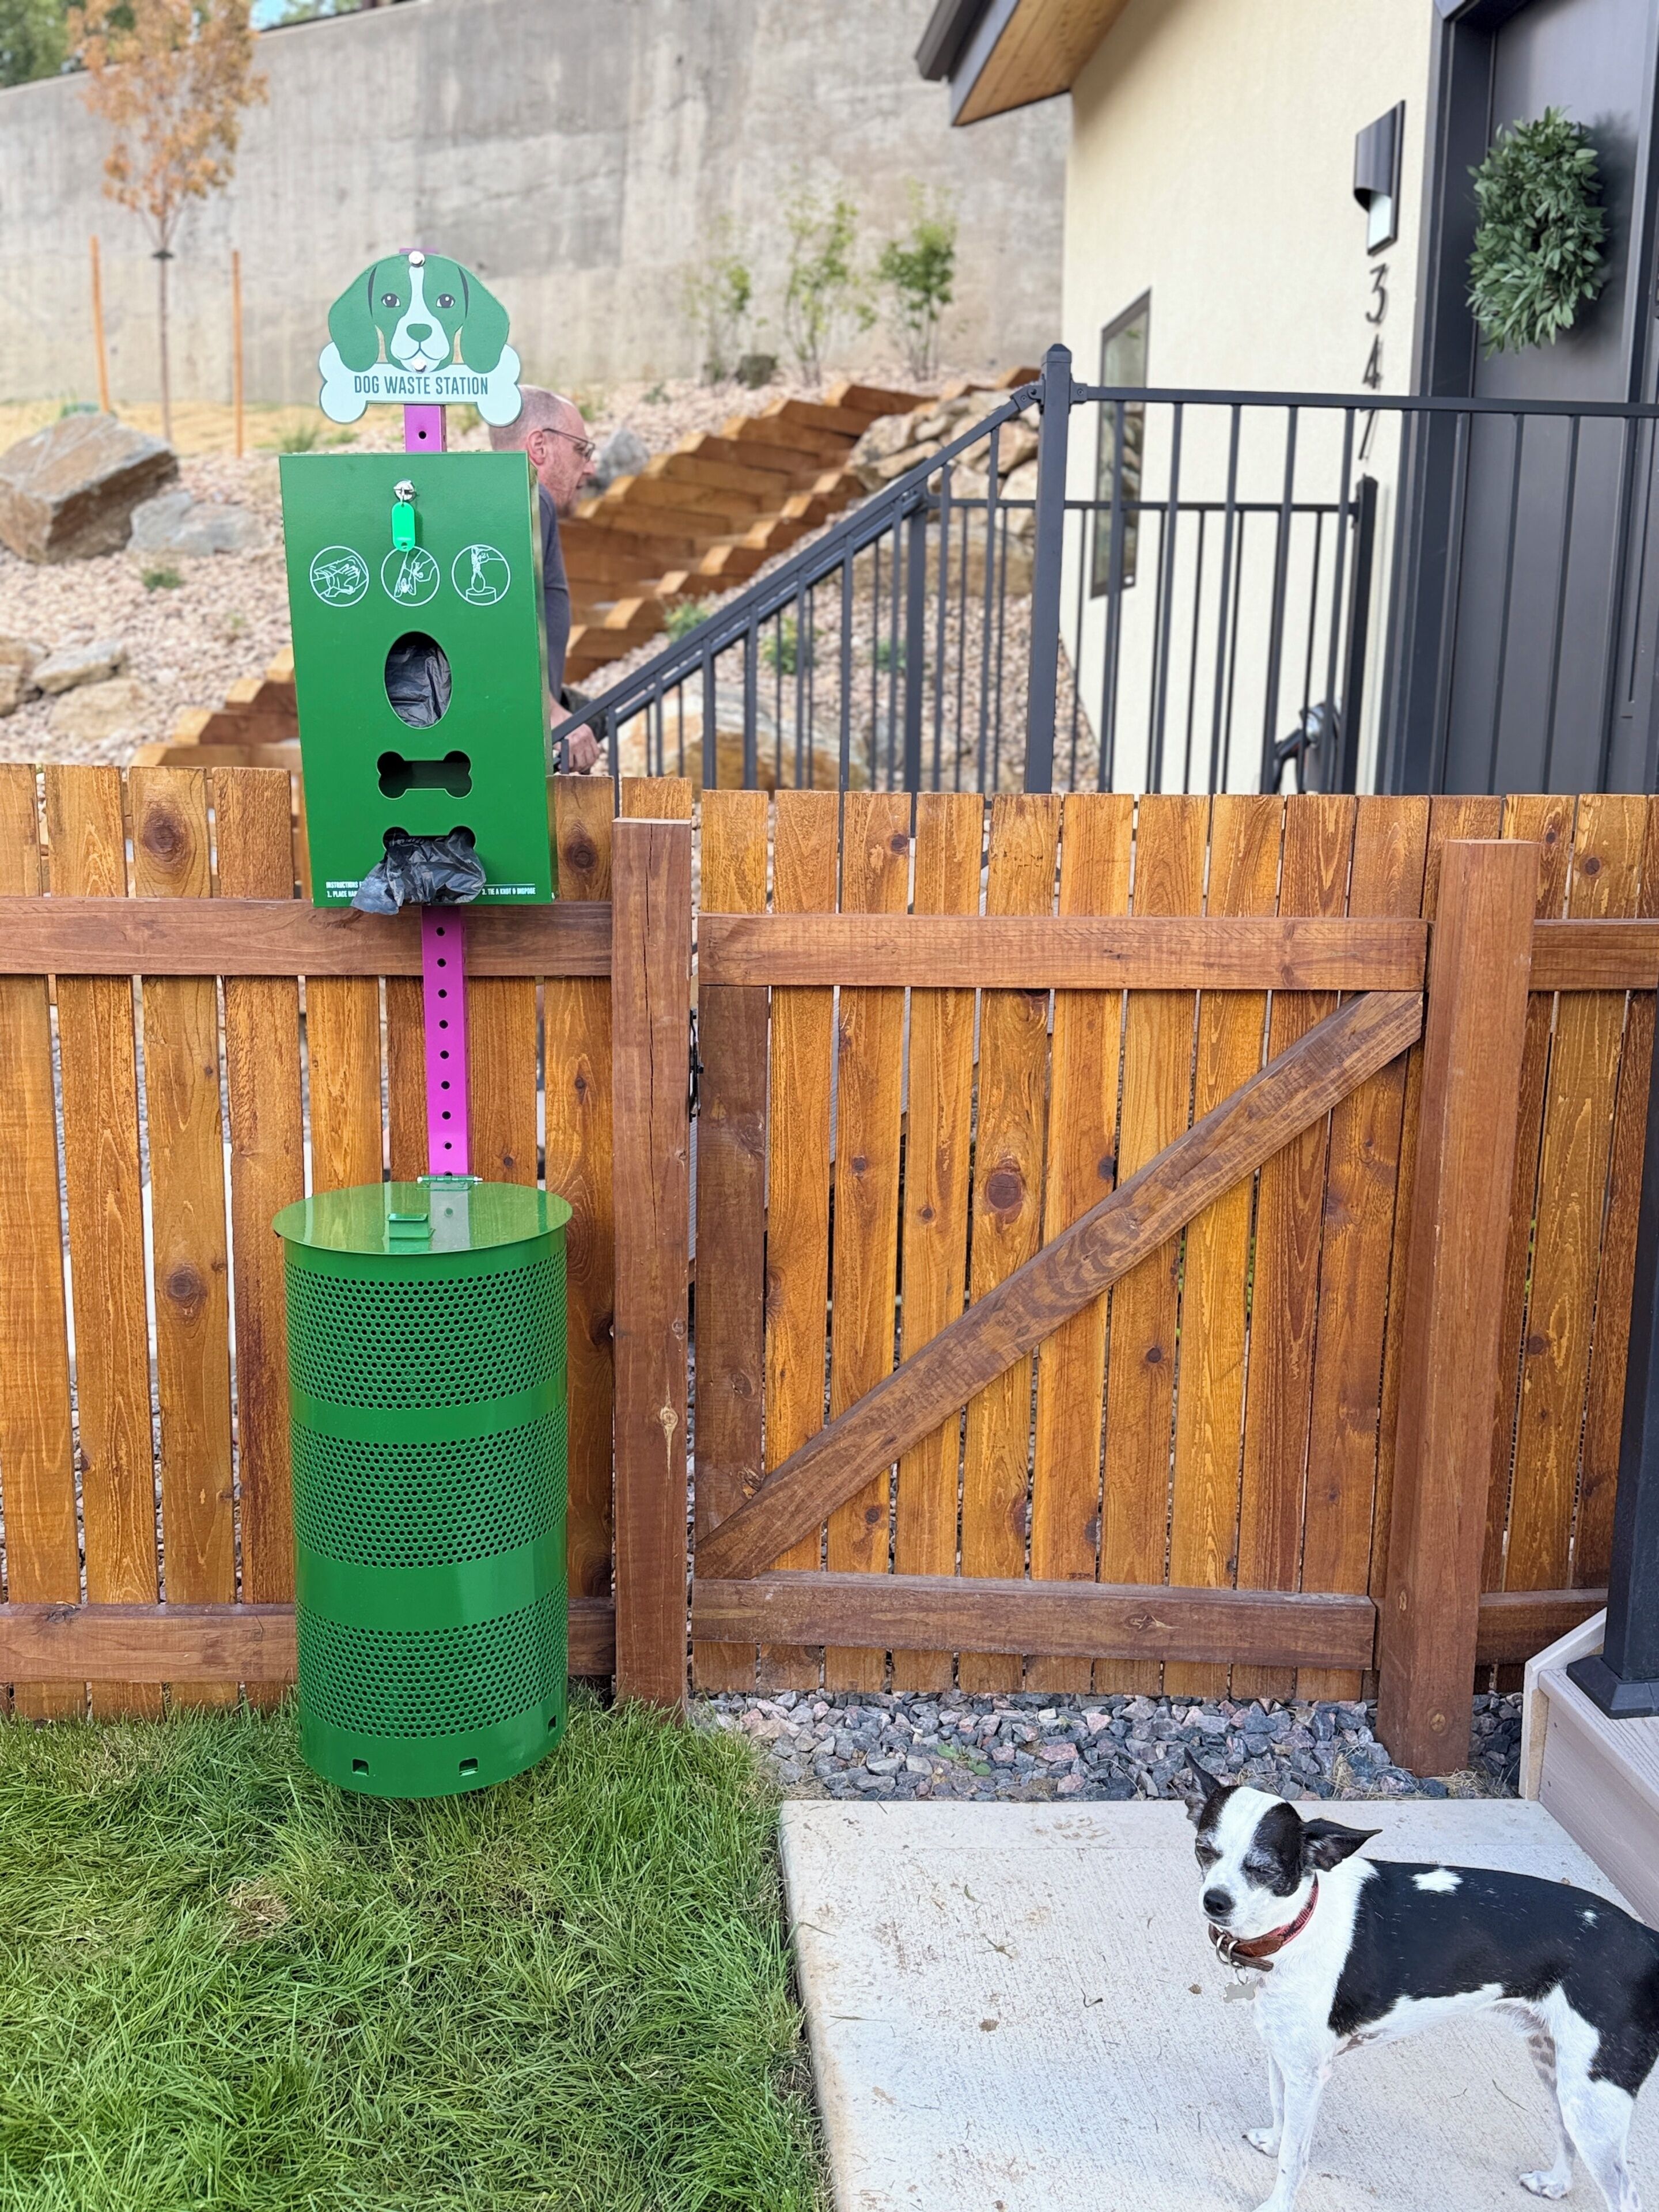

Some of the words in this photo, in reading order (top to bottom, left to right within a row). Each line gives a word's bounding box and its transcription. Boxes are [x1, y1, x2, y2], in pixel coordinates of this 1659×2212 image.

[354, 376, 379, 394] DOG
[384, 376, 430, 395] WASTE
[435, 377, 488, 395] STATION
